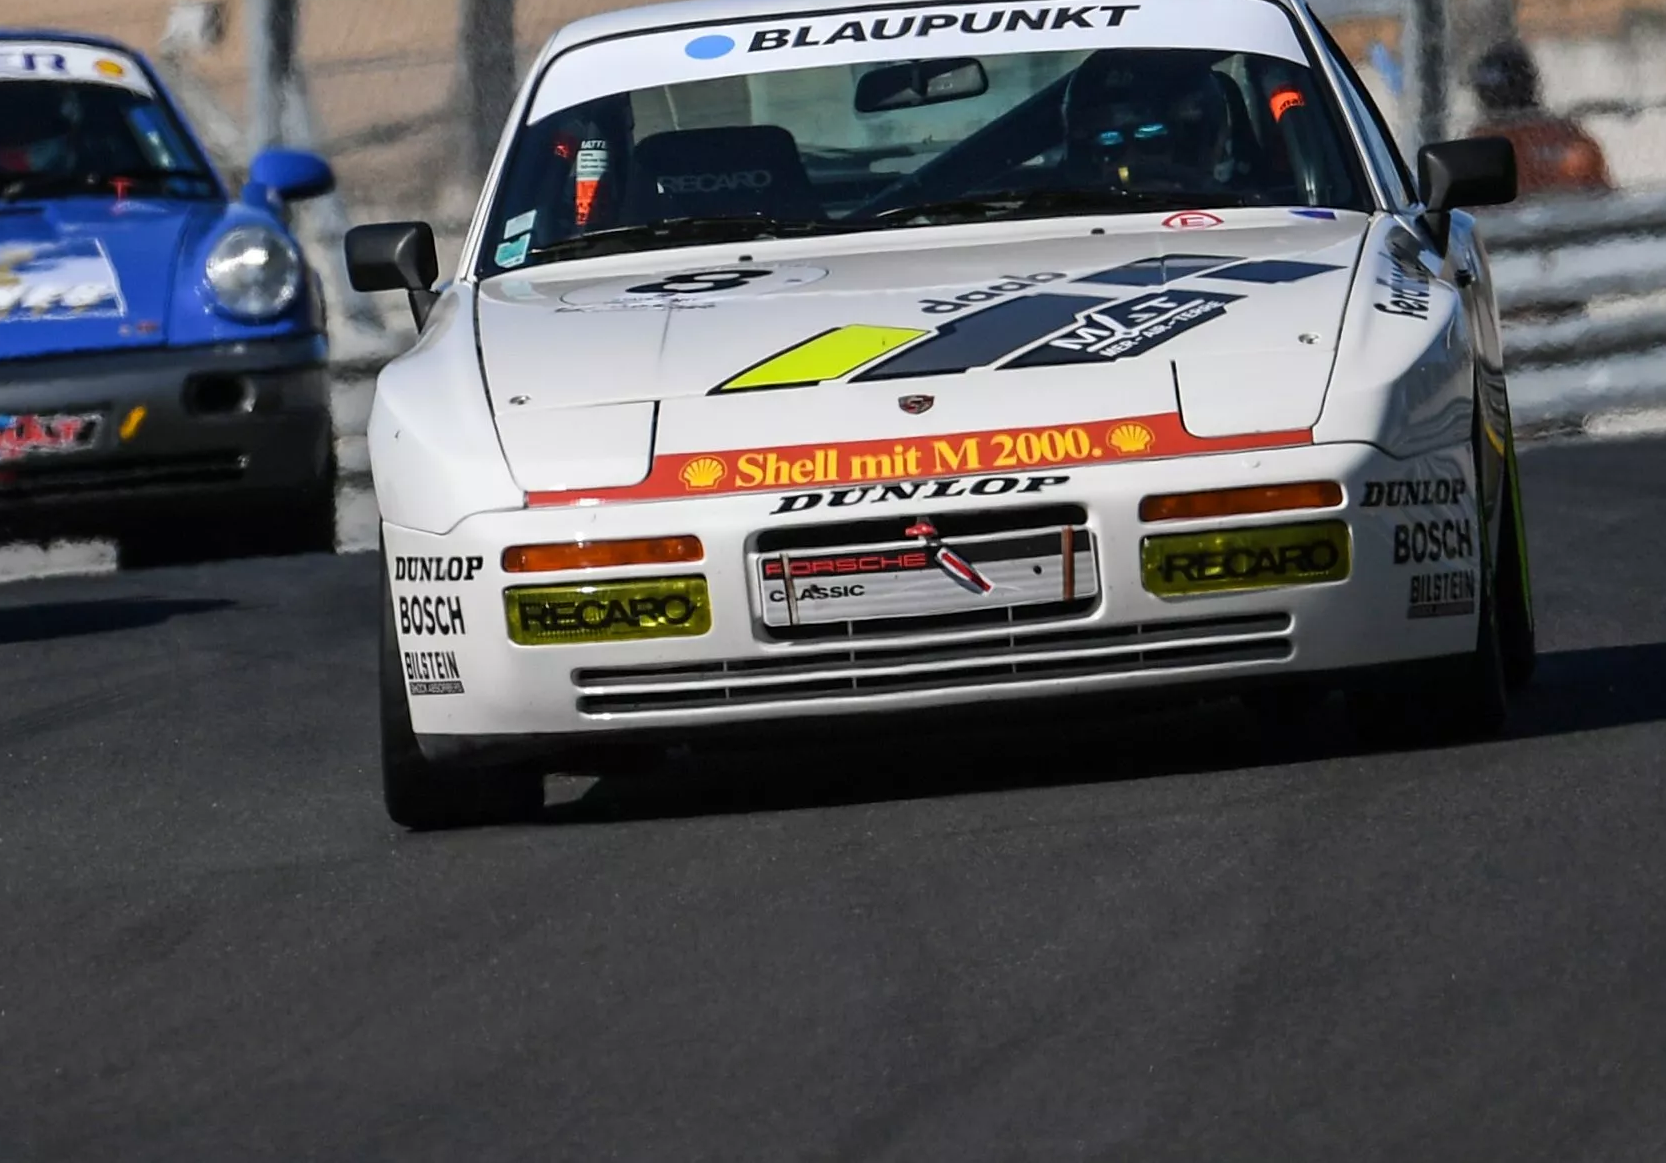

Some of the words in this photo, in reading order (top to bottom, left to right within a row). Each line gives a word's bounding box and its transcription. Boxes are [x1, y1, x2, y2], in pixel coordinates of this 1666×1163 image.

[747, 4, 1141, 54] BLAUPUNKT
[656, 170, 772, 194] RECARO
[624, 269, 774, 294] 8
[735, 448, 839, 488] Shell
[849, 443, 922, 480] mit
[933, 437, 981, 472] M
[992, 427, 1103, 467] 2000.
[769, 474, 1072, 516] DUNLOP
[1359, 478, 1469, 508] DUNLOP
[1393, 517, 1473, 566] BOSCH
[394, 555, 484, 582] DUNLOP
[764, 552, 928, 577] PORSCHE
[1162, 540, 1339, 583] RECARO
[768, 583, 866, 603] CASSIC
[1409, 570, 1475, 604] BILSTEIN
[399, 595, 467, 636] BOSCH
[518, 594, 696, 632] RECARO
[404, 650, 461, 680] BILSTEIN
